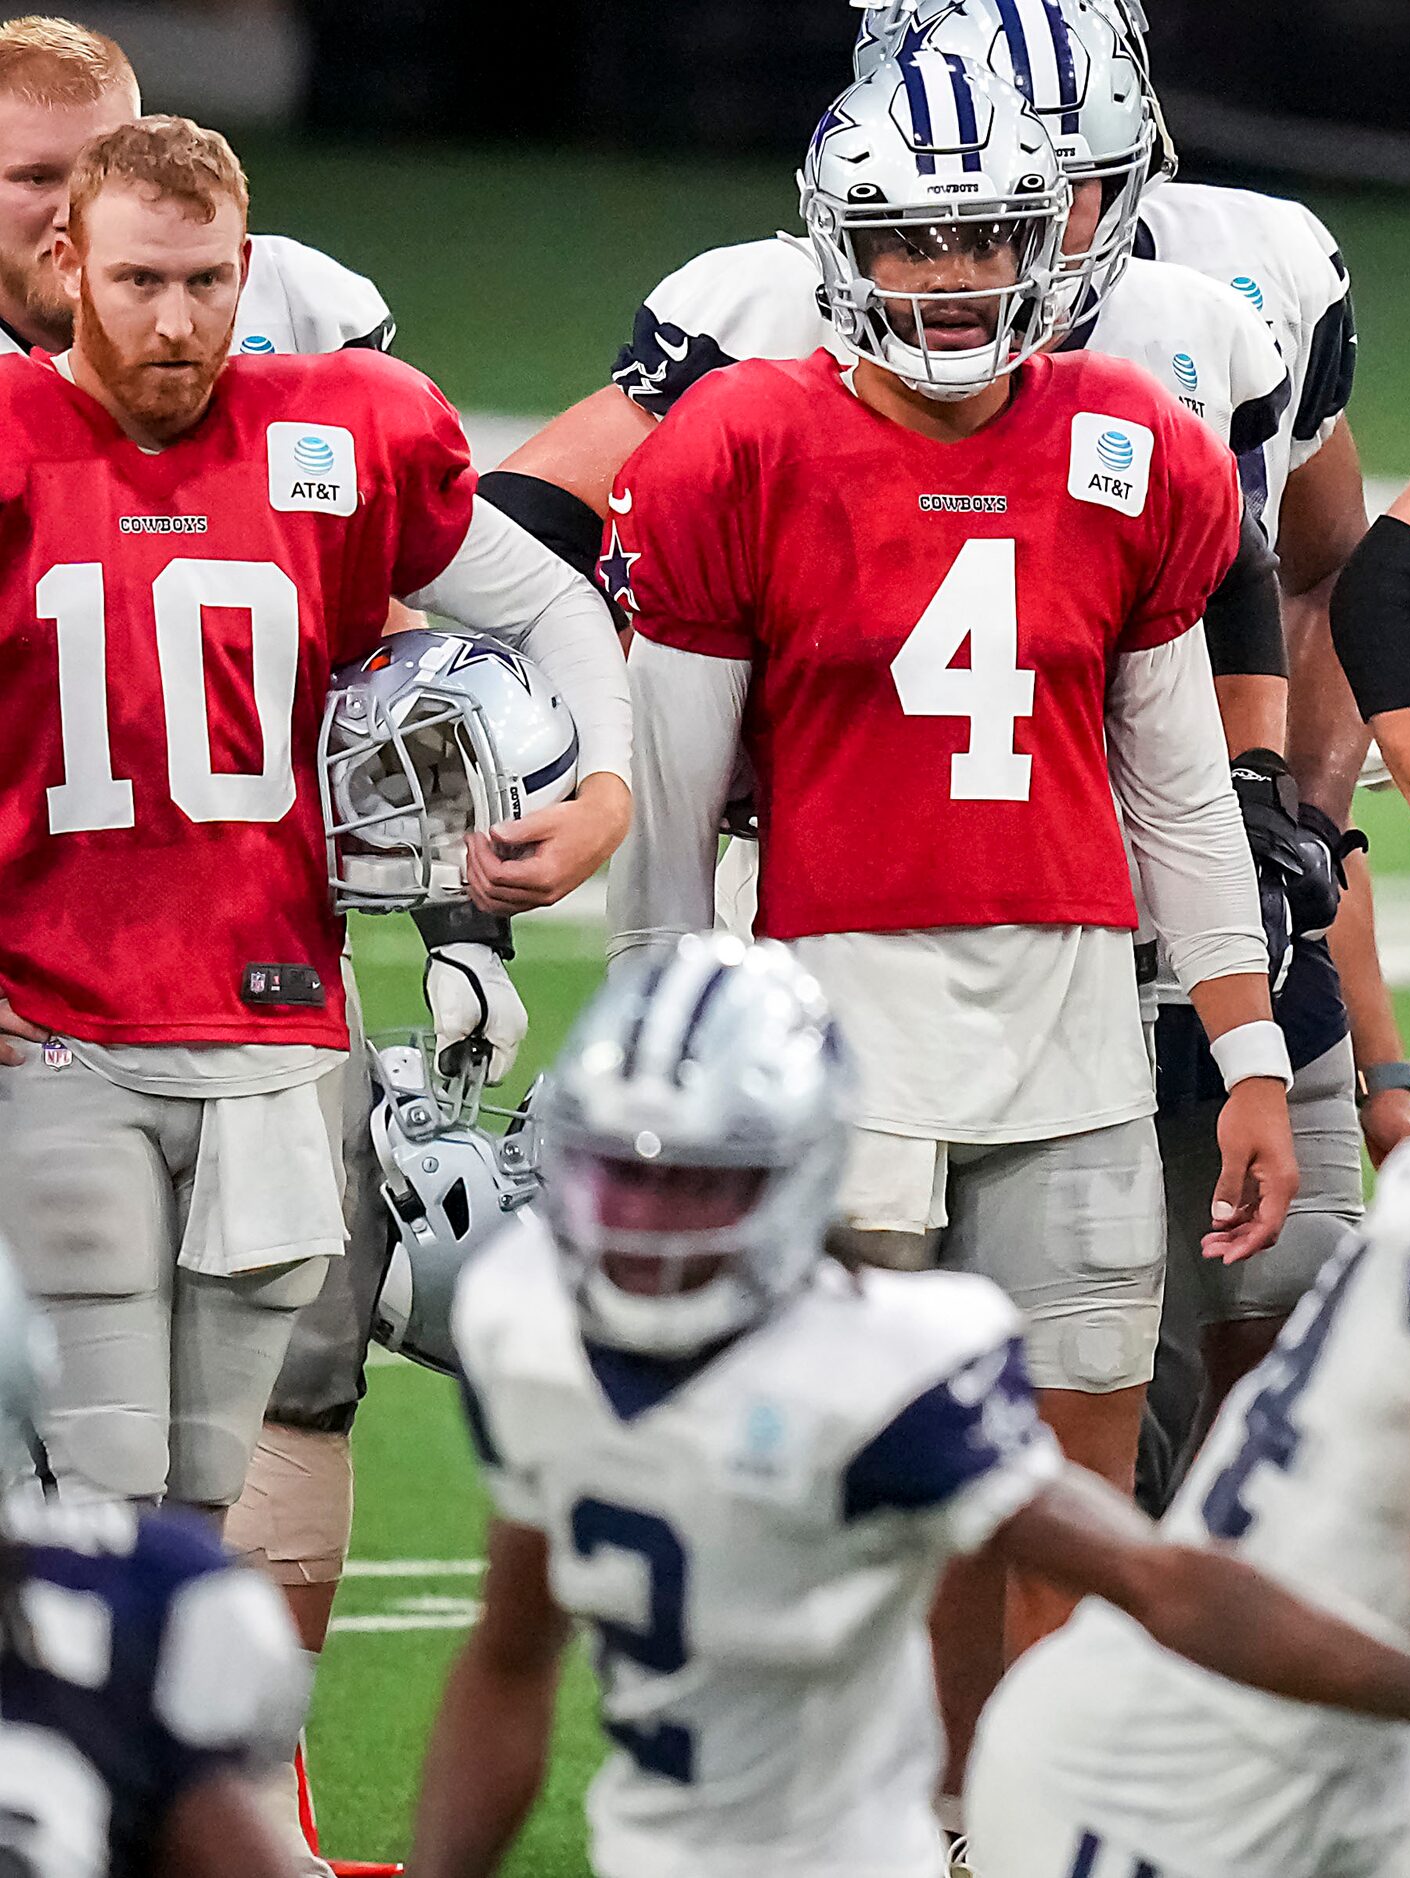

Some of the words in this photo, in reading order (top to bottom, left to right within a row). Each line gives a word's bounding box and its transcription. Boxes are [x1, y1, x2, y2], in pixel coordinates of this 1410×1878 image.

[927, 183, 979, 194] COWBOYS
[290, 480, 341, 501] AT&T
[1088, 473, 1133, 500] AT&T
[919, 494, 1007, 512] COWBOYS
[119, 516, 207, 533] COWBOYS
[889, 538, 1037, 803] 4
[35, 558, 299, 836] 10
[570, 1497, 692, 1783] 2
